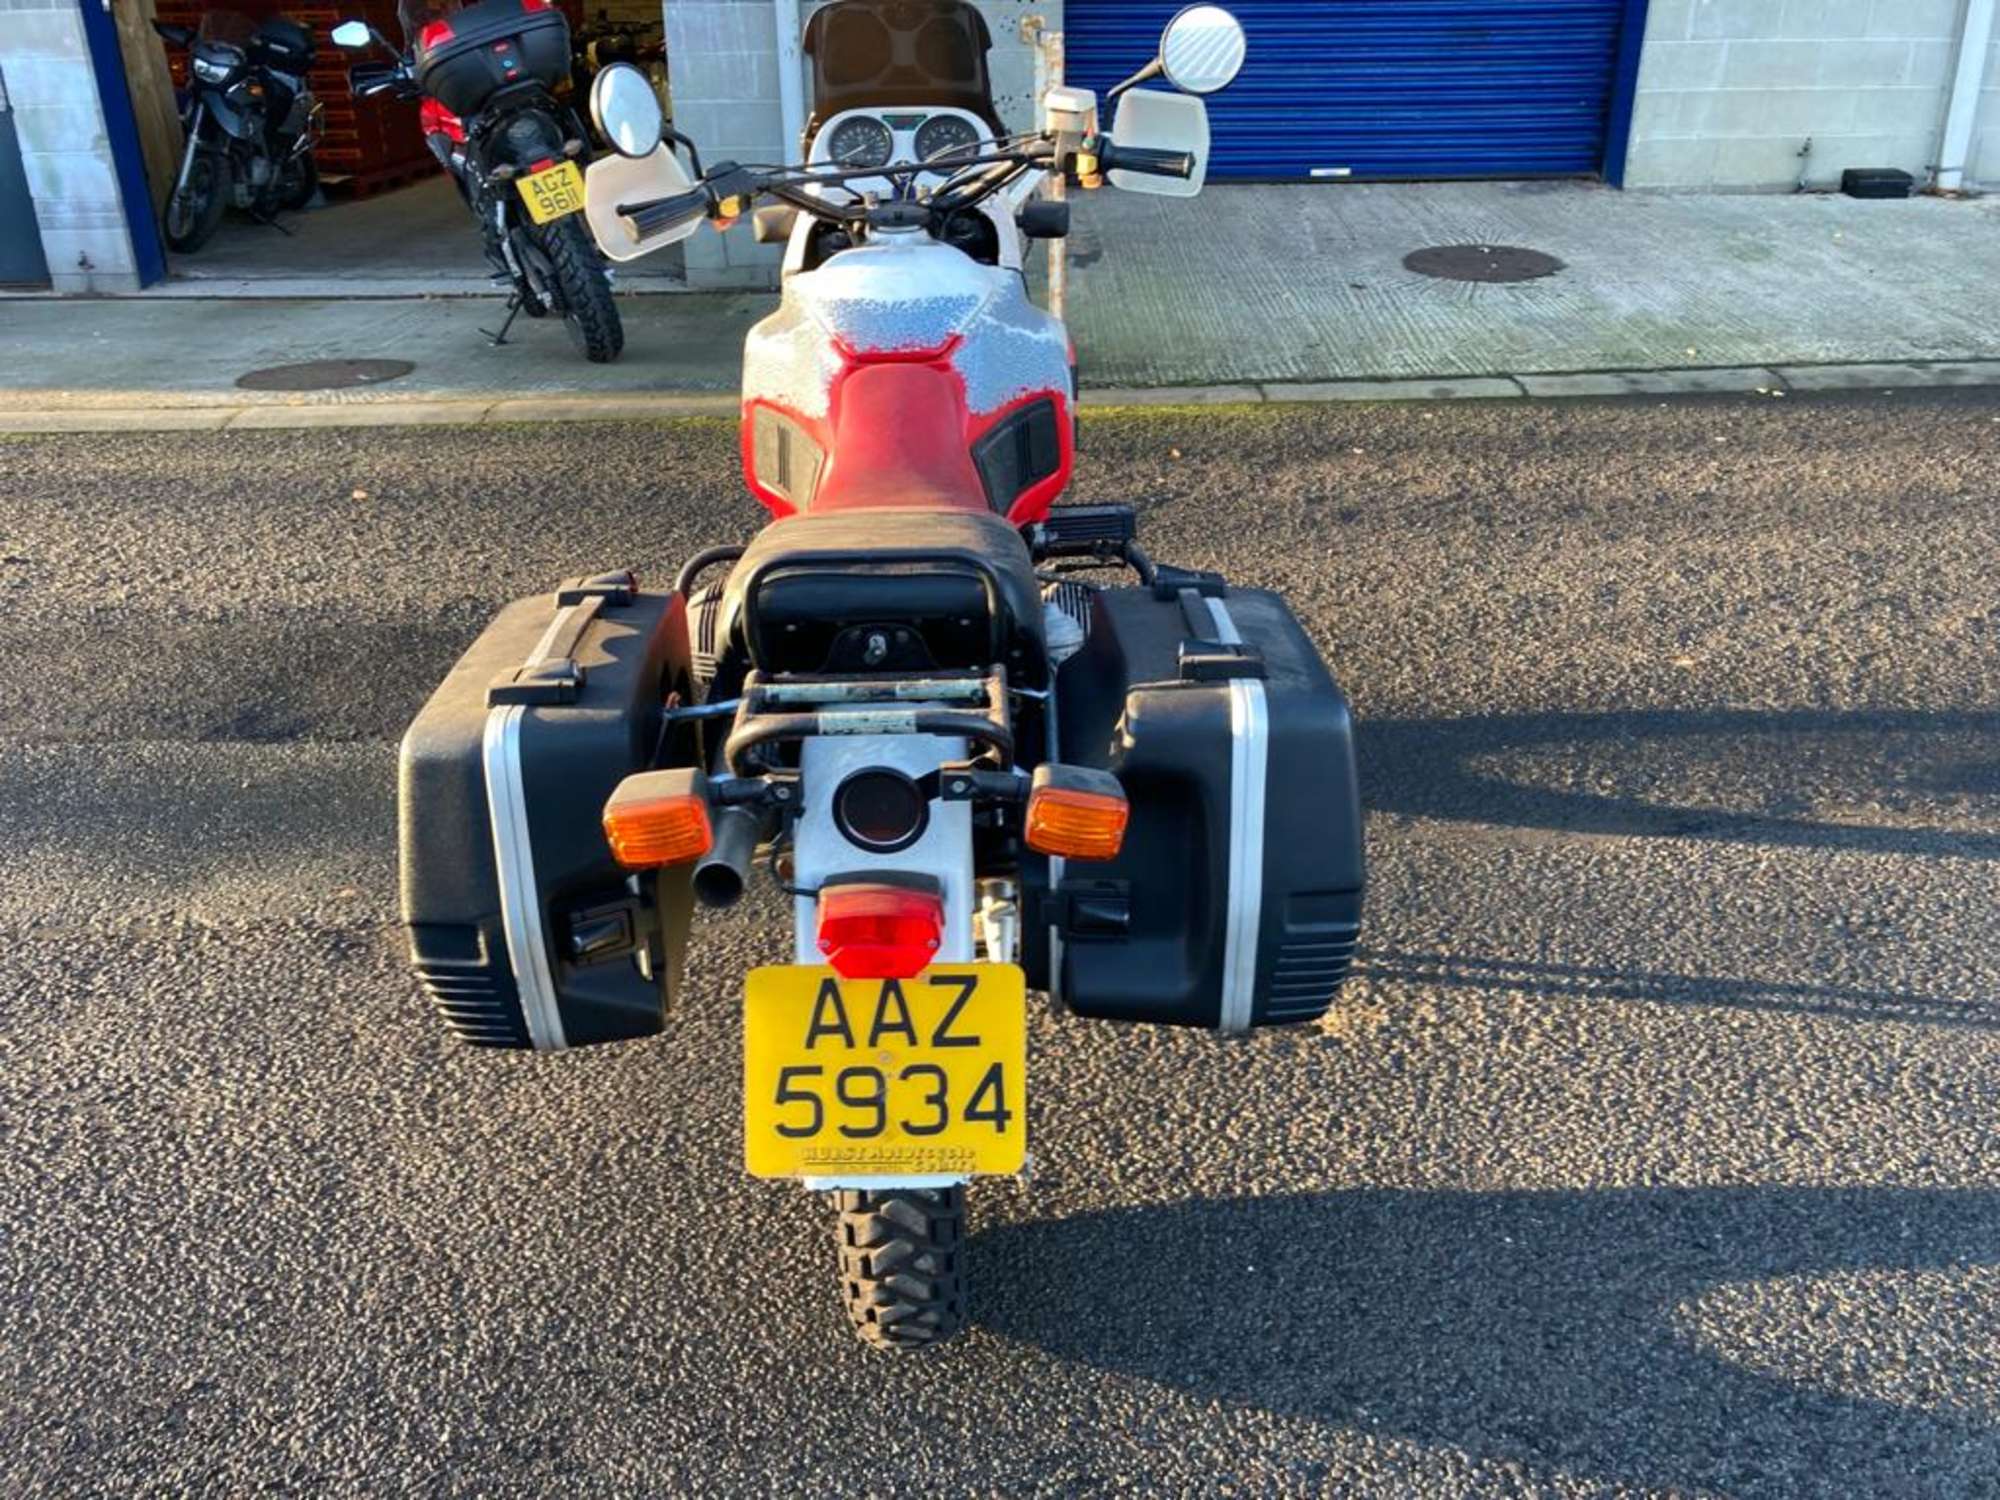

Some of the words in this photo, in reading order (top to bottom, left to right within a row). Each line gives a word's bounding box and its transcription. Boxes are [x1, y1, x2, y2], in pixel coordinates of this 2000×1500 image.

[532, 167, 573, 194] AGZ
[804, 974, 981, 1049] AAZ
[774, 1062, 1012, 1138] 5934
